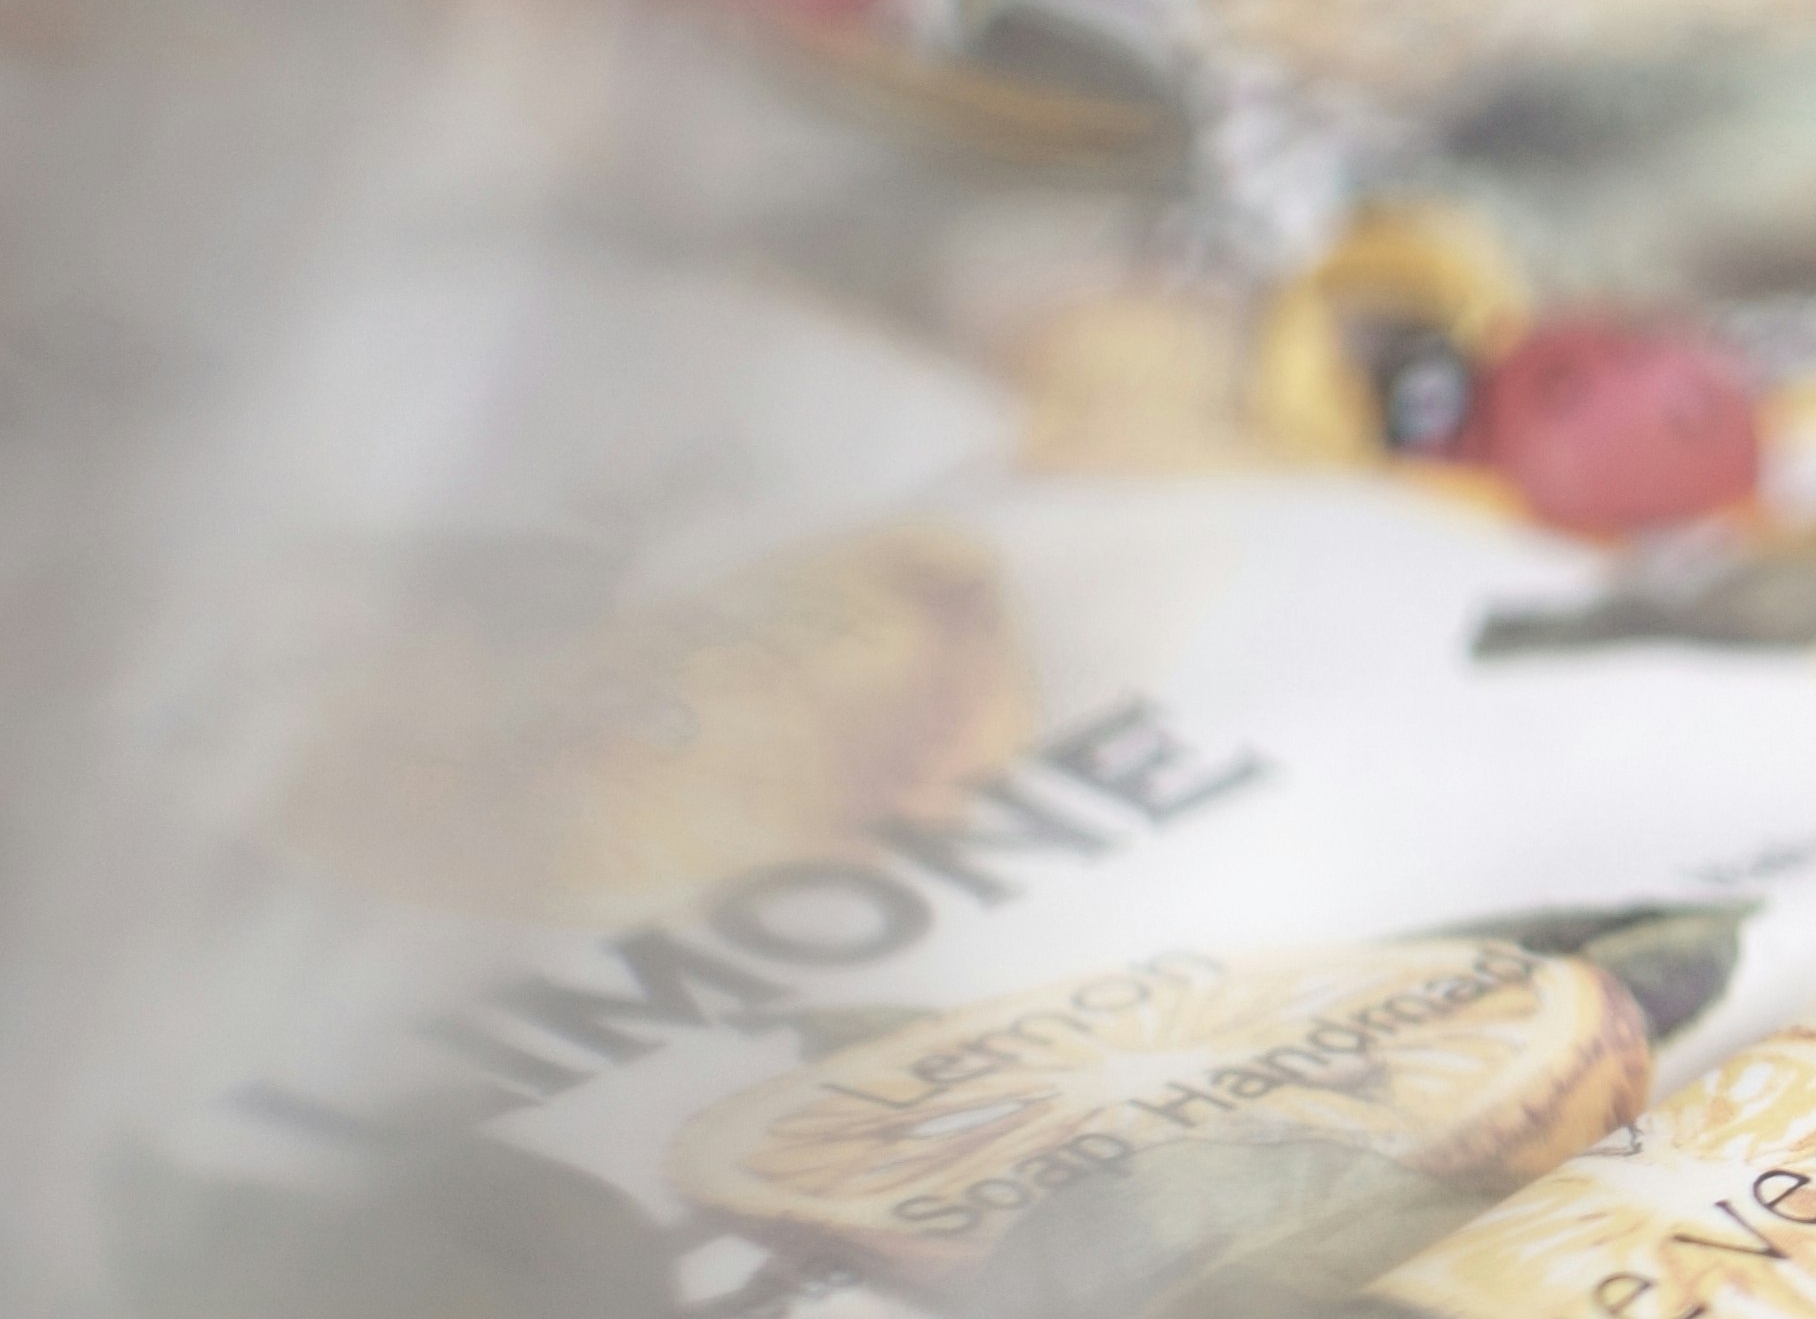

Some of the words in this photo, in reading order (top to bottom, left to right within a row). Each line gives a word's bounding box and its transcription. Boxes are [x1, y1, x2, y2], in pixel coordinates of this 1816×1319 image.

[817, 946, 1228, 1113] Lemon
[890, 1129, 1136, 1239] Soap
[1128, 933, 1540, 1129] Handmad
